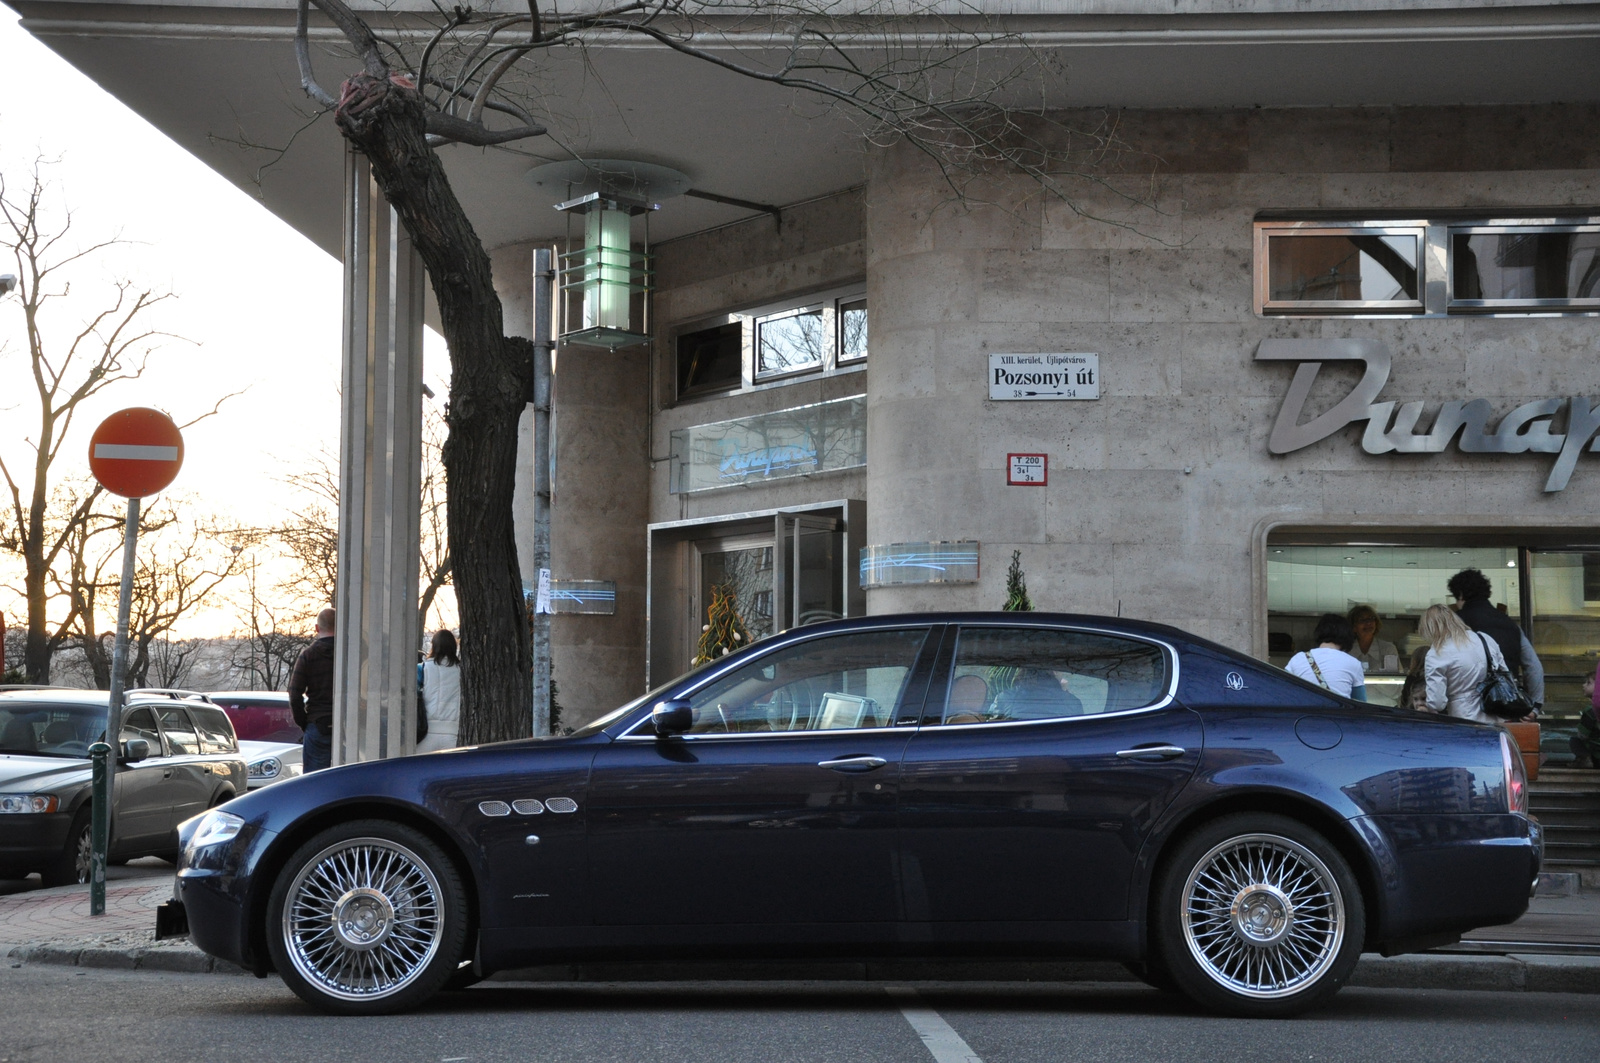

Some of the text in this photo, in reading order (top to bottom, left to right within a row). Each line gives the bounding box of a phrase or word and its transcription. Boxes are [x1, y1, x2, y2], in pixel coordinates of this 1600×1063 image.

[1001, 354, 1086, 365] XIII. kerület, Újlipótváros
[994, 368, 1094, 388] Pozsonyi út
[1013, 389, 1076, 398] 38 54
